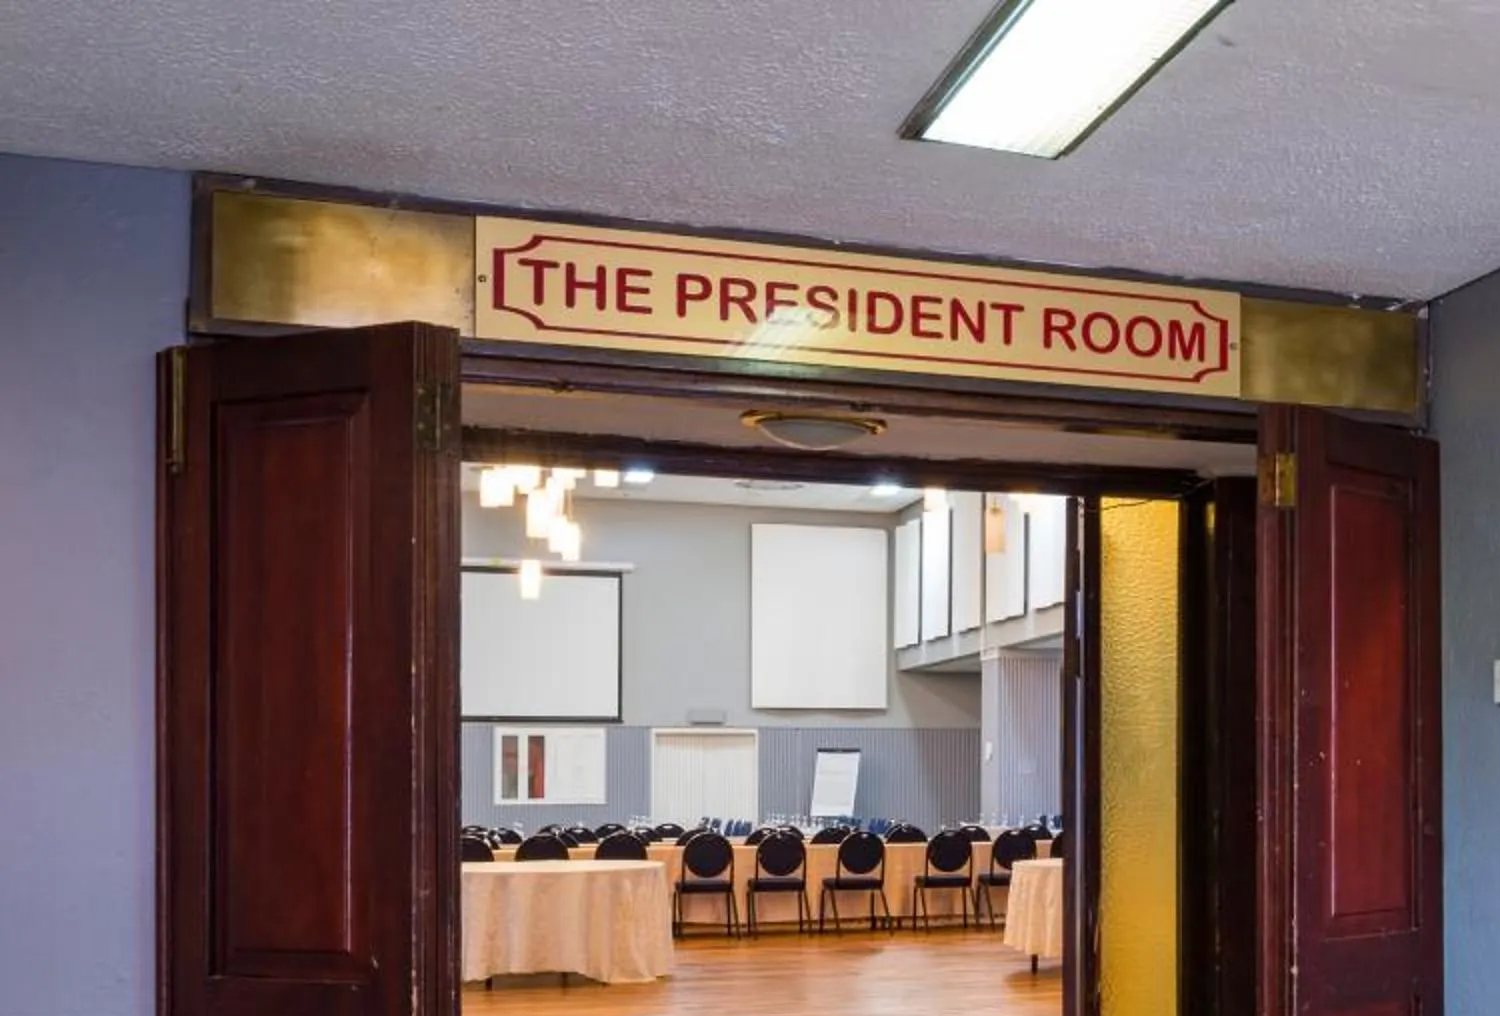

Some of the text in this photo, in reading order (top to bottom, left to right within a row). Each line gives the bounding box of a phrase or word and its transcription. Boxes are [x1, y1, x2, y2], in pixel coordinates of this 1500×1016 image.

[517, 257, 1206, 363] THE PRESIDENT ROOM
